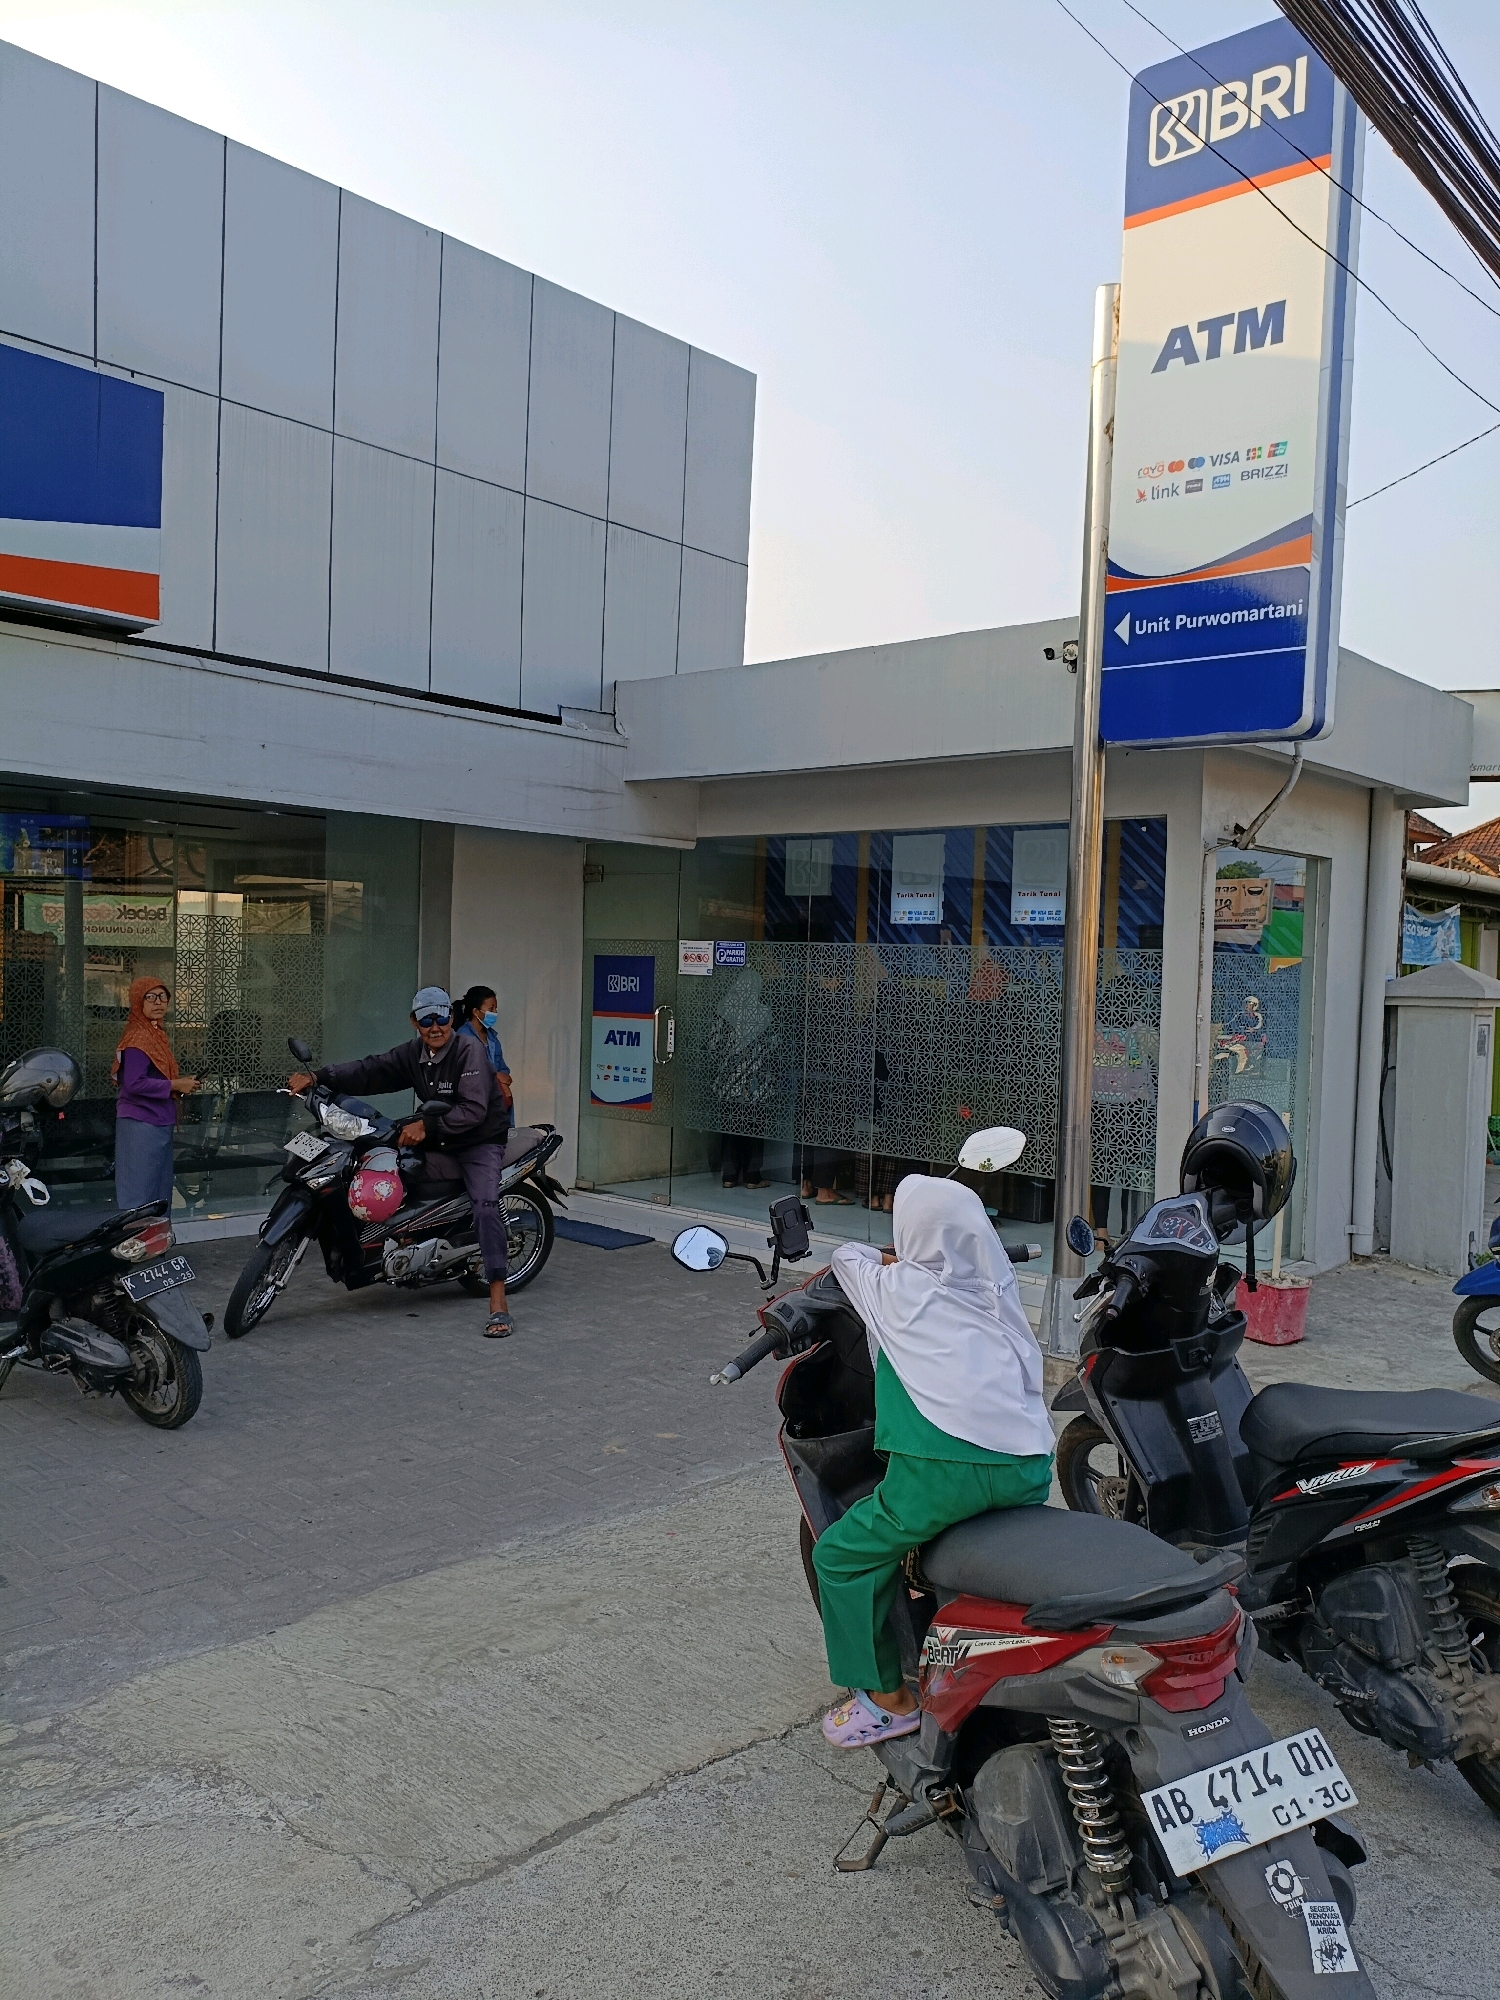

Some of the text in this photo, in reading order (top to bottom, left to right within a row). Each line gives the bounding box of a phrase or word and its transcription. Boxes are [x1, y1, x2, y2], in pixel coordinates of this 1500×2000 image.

[1209, 55, 1308, 144] BRI
[1151, 299, 1287, 374] ATM
[1209, 451, 1240, 467] VISA
[1151, 482, 1180, 500] link
[1240, 463, 1288, 481] BRIZZI
[1135, 599, 1303, 635] Unit Purwomartani
[620, 975, 640, 992] BRI
[604, 1029, 641, 1047] ATM
[124, 1257, 185, 1290] K 2744 GP
[1187, 1716, 1231, 1737] HONDA
[1151, 1734, 1334, 1834] AB 4714 QH
[1283, 1897, 1305, 1911] POINT
[1310, 1919, 1342, 1927] MANDALA
[1316, 1926, 1338, 1935] KRIDA
